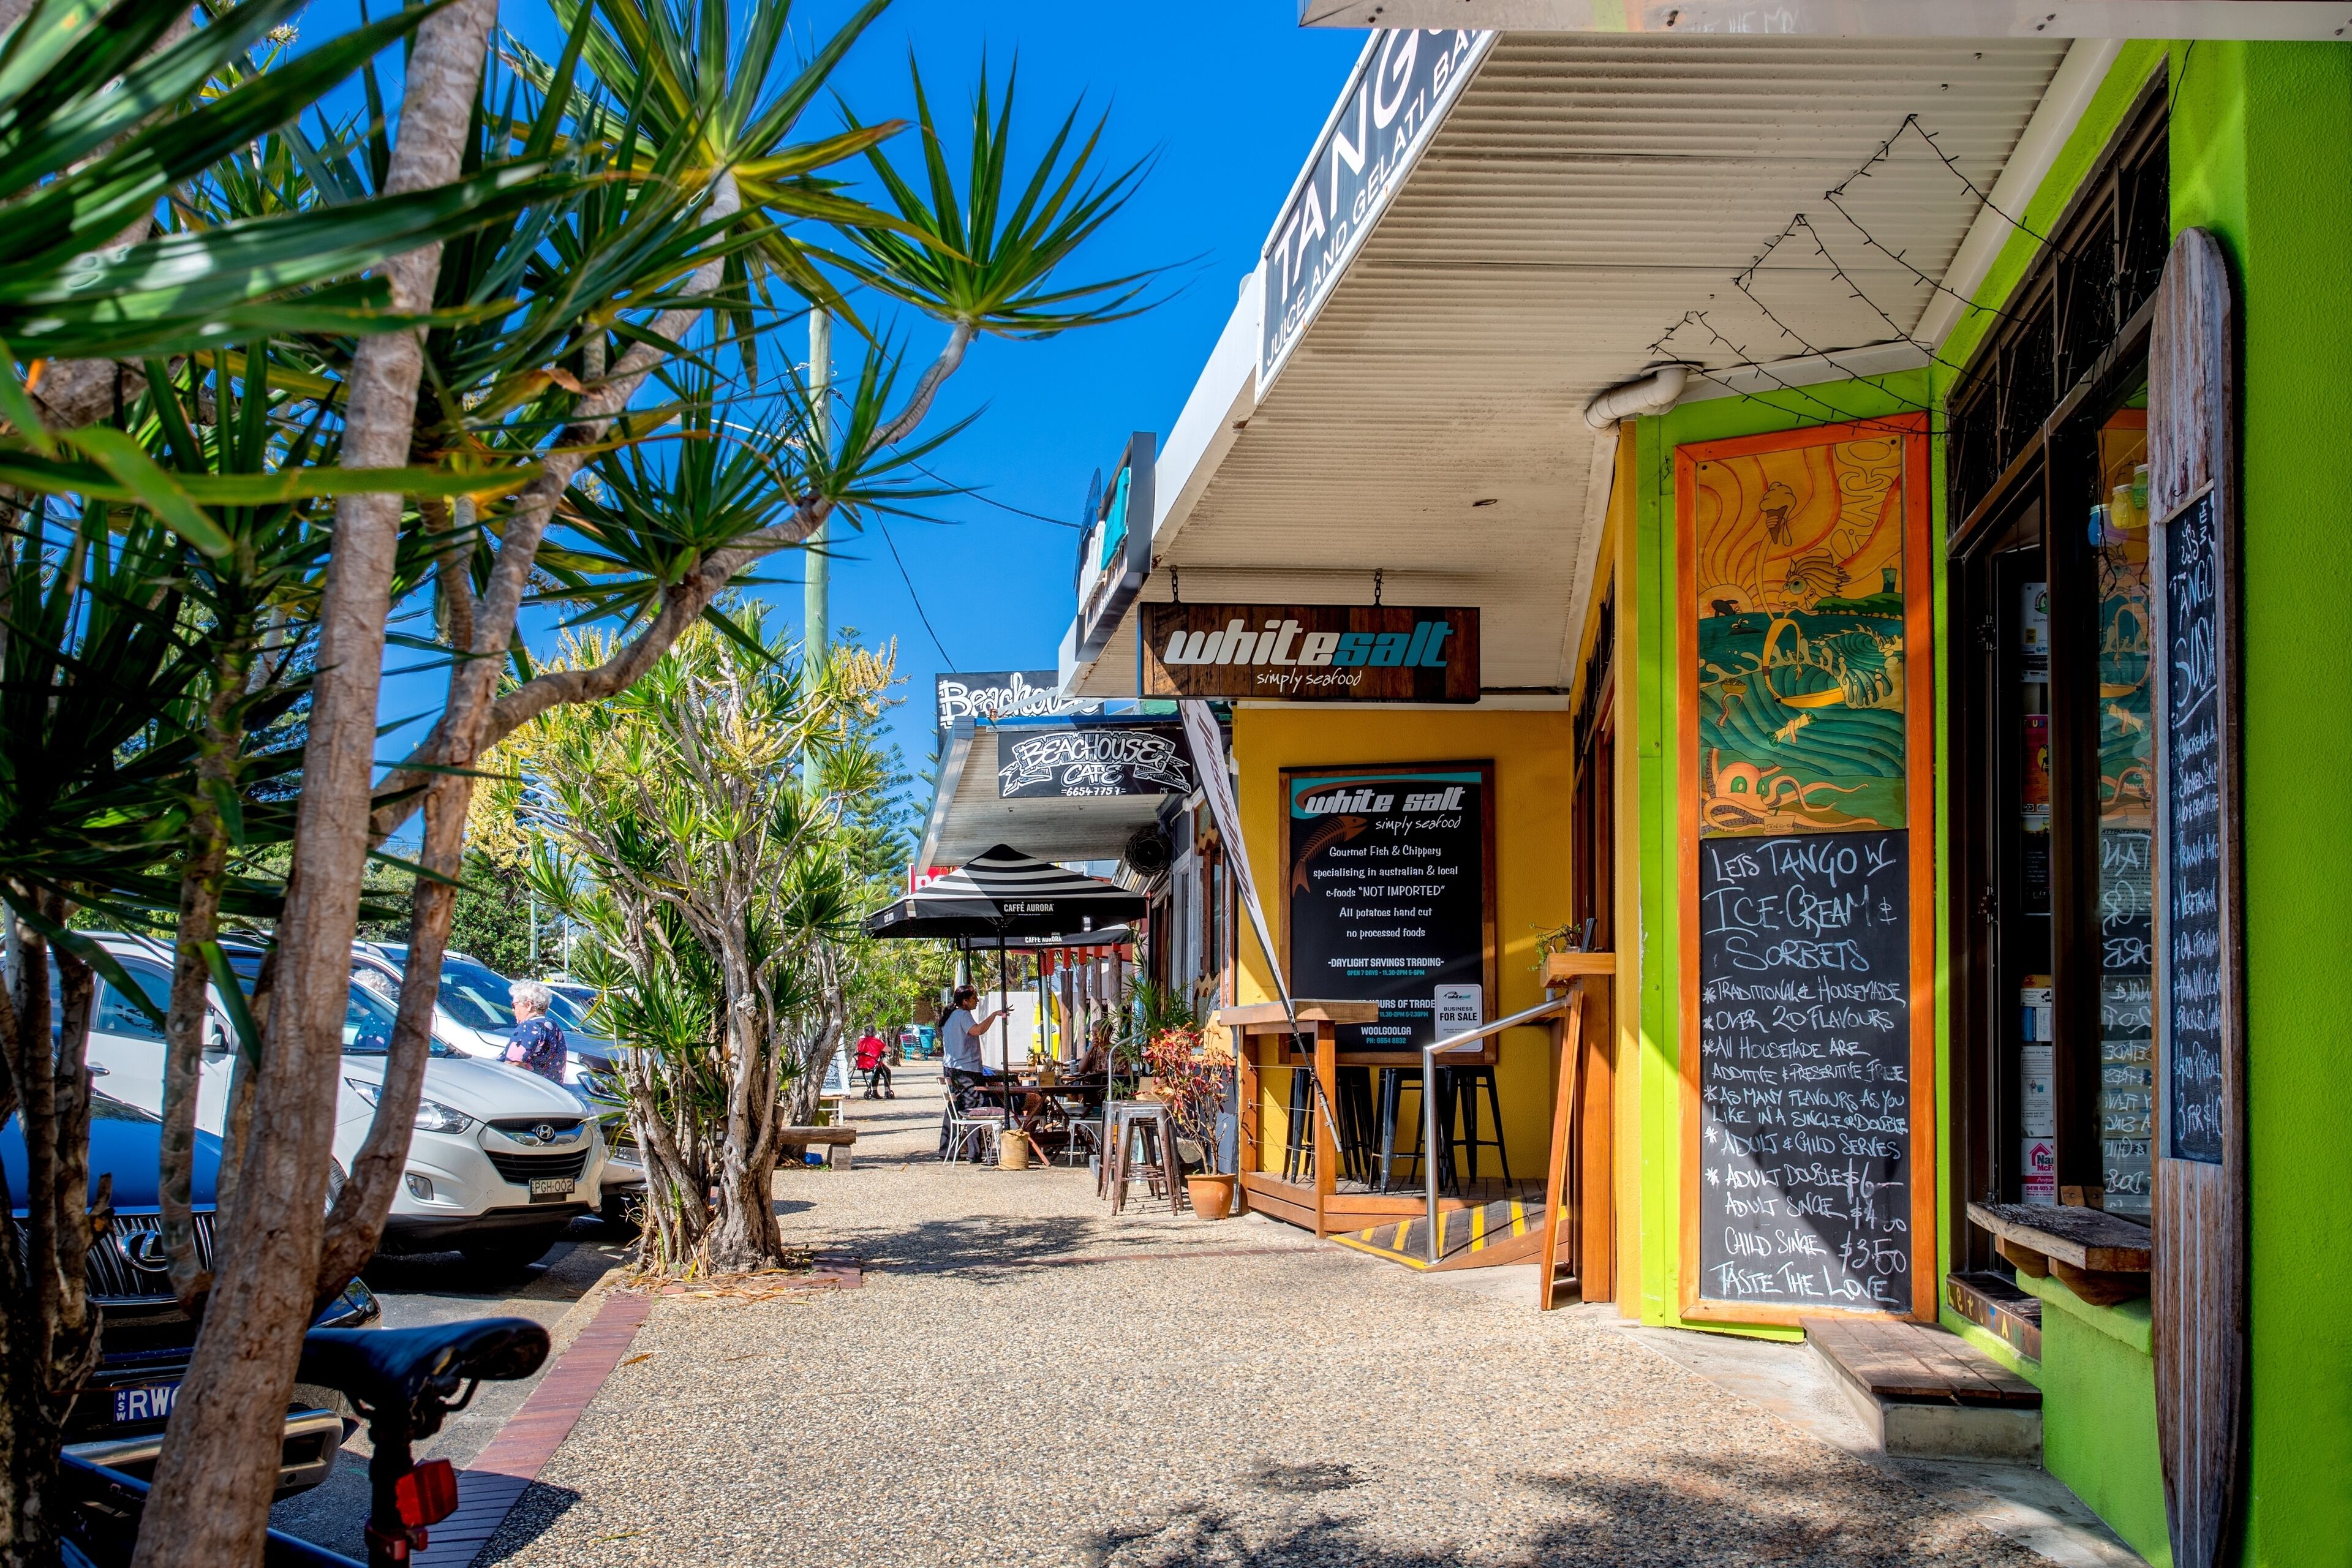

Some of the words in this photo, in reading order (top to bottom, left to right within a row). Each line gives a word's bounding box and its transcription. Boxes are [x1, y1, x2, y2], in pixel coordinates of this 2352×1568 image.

[1275, 28, 1444, 306] TANG
[1266, 285, 1306, 369] JUICE
[1310, 223, 1348, 298] AND
[1352, 88, 1425, 227] GELATI
[1256, 668, 1303, 693] simply
[1306, 667, 1363, 687] seafood
[1019, 734, 1169, 769] BEACHOUSE
[1305, 789, 1395, 814] white
[1402, 786, 1466, 812] salt
[1375, 815, 1413, 836] simply
[1415, 814, 1461, 830] seafood
[1329, 846, 1367, 857] Gourmet
[1370, 845, 1389, 856] Fish
[1392, 845, 1400, 856] &
[1402, 845, 1441, 858] Chippery
[1755, 839, 1858, 889] TANGO
[1313, 867, 1365, 879] specialising
[1368, 867, 1376, 876] in
[1379, 867, 1424, 876] australian
[1426, 865, 1435, 876] &
[1438, 865, 1458, 875] local
[1325, 888, 1356, 897] c-foods
[1027, 903, 1054, 912] AURORA
[1339, 907, 1353, 918] All
[1355, 908, 1391, 919] potatoes
[1393, 907, 1416, 917] hand
[1417, 907, 1433, 917] cut
[1702, 884, 1872, 938] ICE-CREAM
[1359, 927, 1401, 940] processed
[1403, 927, 1426, 937] foods
[1370, 958, 1405, 967] SAVINGS
[1725, 936, 1870, 972] SORBETS
[1370, 999, 1396, 1009] OURS
[1397, 999, 1408, 1009] OF
[1409, 999, 1436, 1009] TRADE
[1817, 974, 1907, 1009] HOUSEMADE
[1439, 1012, 1455, 1021] FOR
[1457, 1012, 1477, 1021] SALE
[1716, 1009, 1771, 1034] OVER
[1772, 1005, 1806, 1033] 20
[1806, 1004, 1895, 1033] FLAVOURS
[1360, 1027, 1412, 1035] WOOLGOOLGA
[1828, 1036, 1871, 1057] ARE
[1864, 1058, 1908, 1084] FREE
[1719, 1086, 1742, 1106] AS
[1744, 1087, 1783, 1109] MANY
[1788, 1088, 1860, 1114] FLAVOURS
[1860, 1088, 1880, 1109] AS
[1882, 1088, 1905, 1116] YOU
[1712, 1105, 1751, 1125] LIKE
[1757, 1105, 1773, 1126] IN
[1774, 1108, 1787, 1126] A
[1792, 1110, 1849, 1130] SINGLE
[1853, 1113, 1909, 1134] DOUBLE
[2187, 1104, 2205, 1134] FOR
[1721, 1129, 1779, 1158] ADULT
[1794, 1130, 1836, 1156] CHILD
[1838, 1133, 1902, 1160] SERVES
[1724, 1163, 1781, 1189] ADULT
[1783, 1162, 1849, 1187] DOUBLE
[1724, 1191, 1779, 1218] ADULT
[1724, 1226, 1773, 1257] CHILD
[1708, 1260, 1784, 1299] TASTE
[1776, 1261, 1825, 1298] THE
[1821, 1264, 1901, 1304] LOVE
